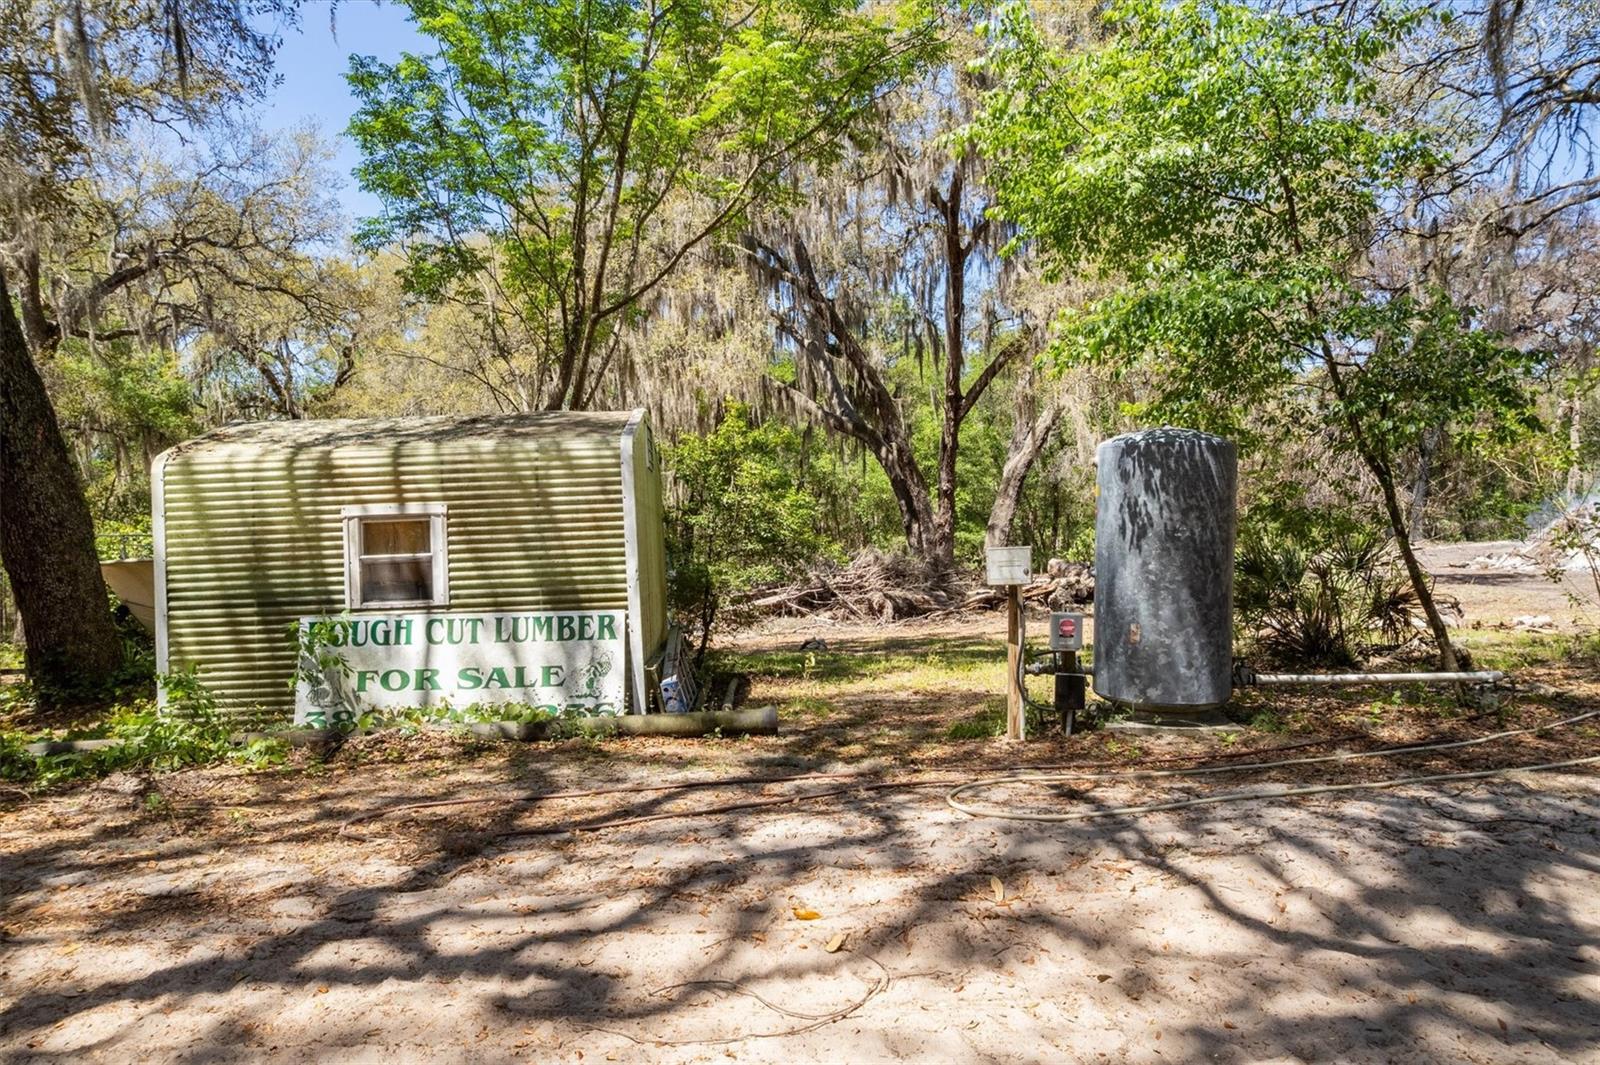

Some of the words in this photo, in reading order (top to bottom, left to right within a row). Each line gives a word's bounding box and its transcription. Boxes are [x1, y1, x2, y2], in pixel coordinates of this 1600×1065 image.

[426, 617, 484, 645] CUT
[494, 614, 617, 644] LUMBER
[356, 668, 442, 692] FOR
[457, 665, 565, 690] SALE
